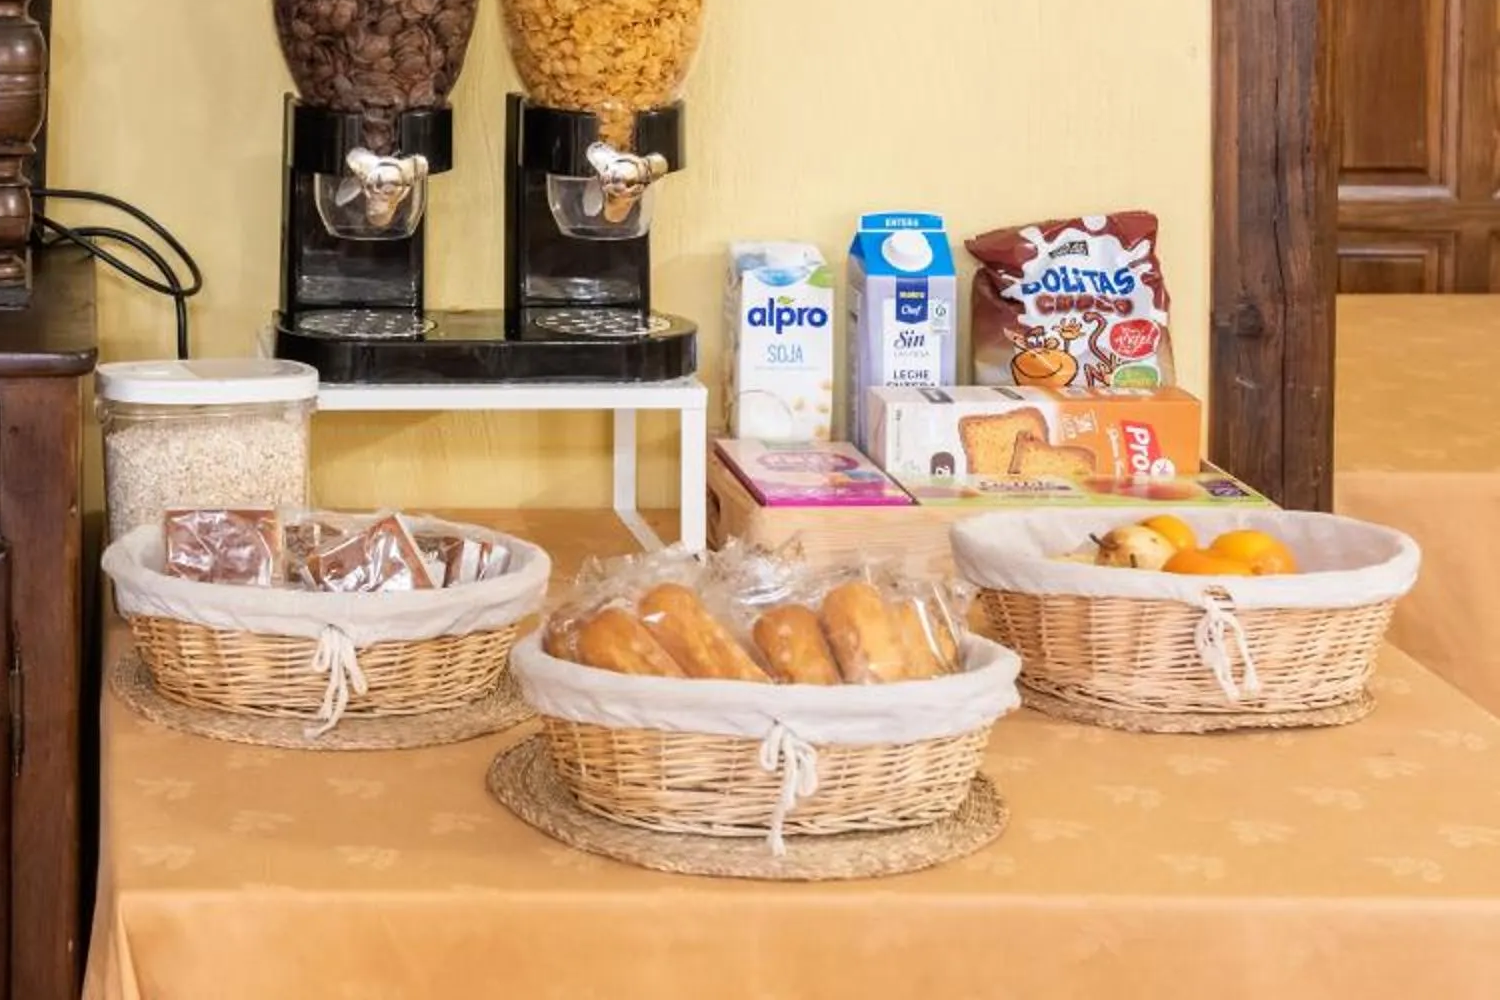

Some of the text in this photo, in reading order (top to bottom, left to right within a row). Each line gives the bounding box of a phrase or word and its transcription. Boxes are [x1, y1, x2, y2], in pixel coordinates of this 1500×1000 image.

[1020, 266, 1136, 295] BOLITAS
[747, 297, 828, 335] alpro
[893, 329, 925, 350] Sin
[766, 343, 804, 363] SOJA
[893, 369, 931, 380] LECHE
